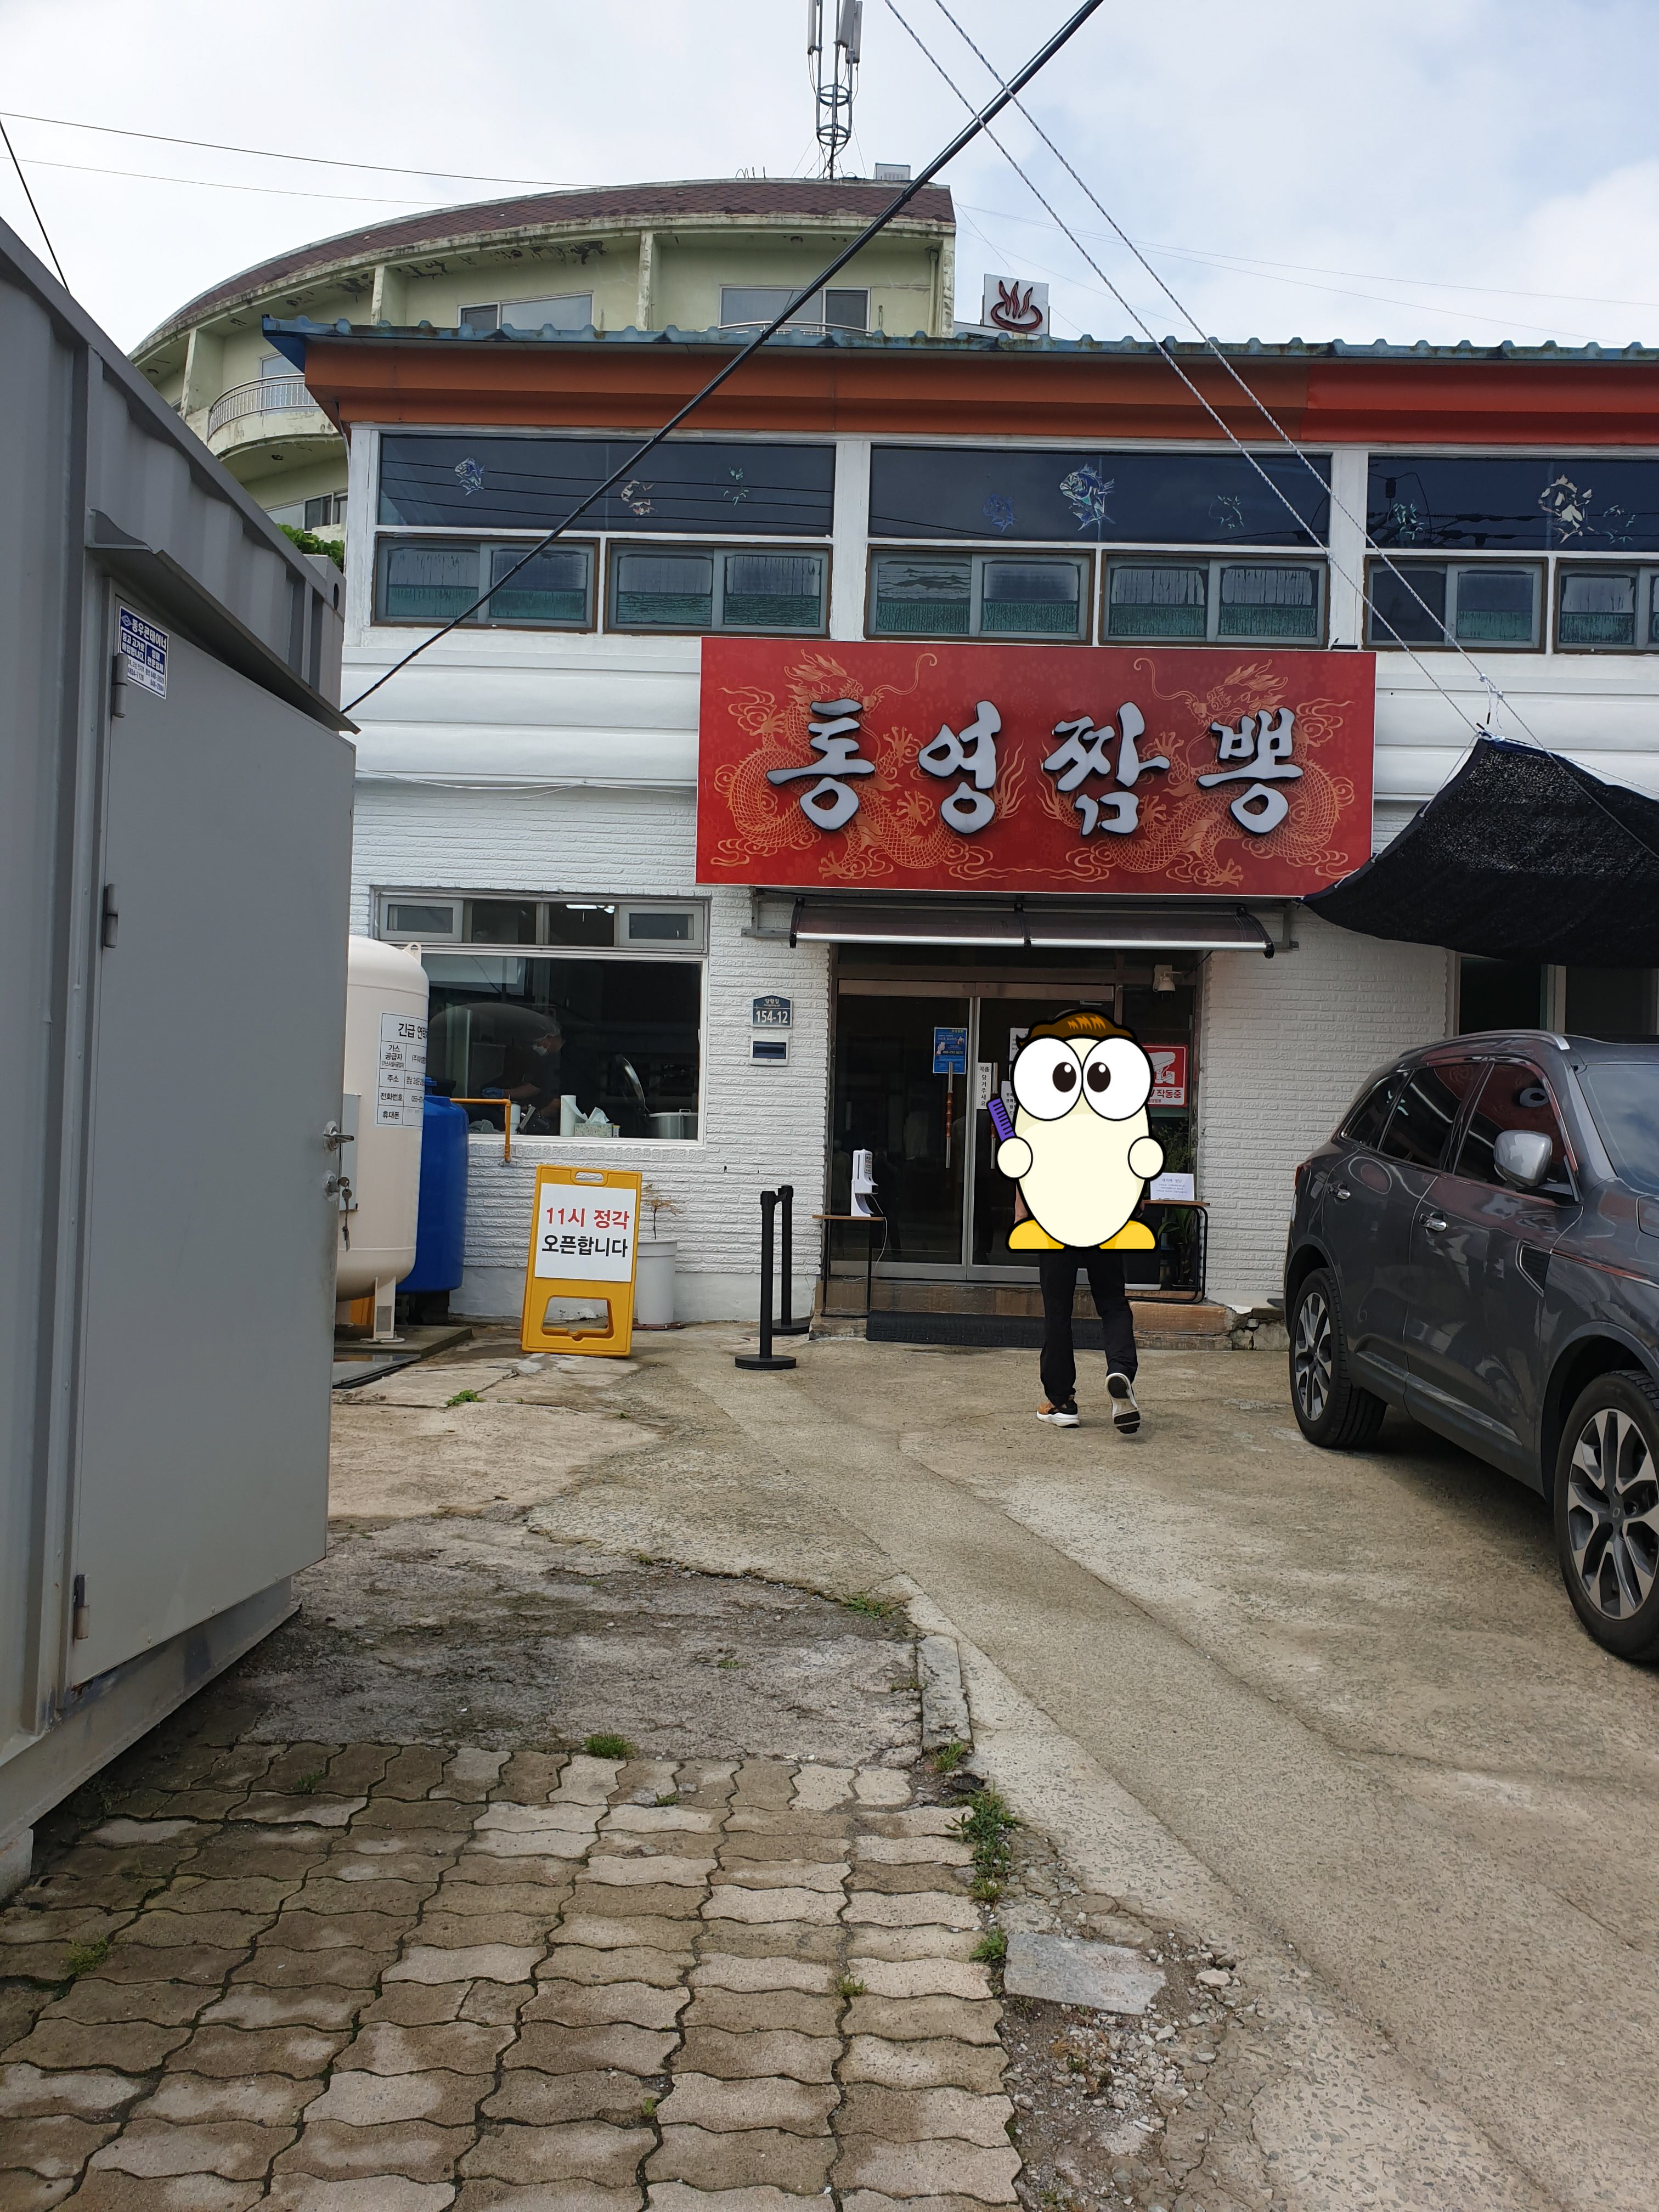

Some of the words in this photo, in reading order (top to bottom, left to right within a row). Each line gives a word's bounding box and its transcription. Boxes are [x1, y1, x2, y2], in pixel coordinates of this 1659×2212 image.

[132, 618, 166, 650] 동우콘테이너
[766, 697, 1304, 835] 통영짬뽕
[756, 1011, 788, 1024] 154-12
[398, 1023, 415, 1038] 긴급
[385, 1052, 402, 1061] 공급자
[387, 1074, 399, 1082] 주소
[380, 1092, 403, 1101] 전화번호
[1157, 1090, 1181, 1098] 작동중
[382, 1110, 399, 1119] 휴대폰
[546, 1207, 586, 1228] 11시
[593, 1209, 630, 1230] 정각
[541, 1234, 628, 1258] 오픈합니다
